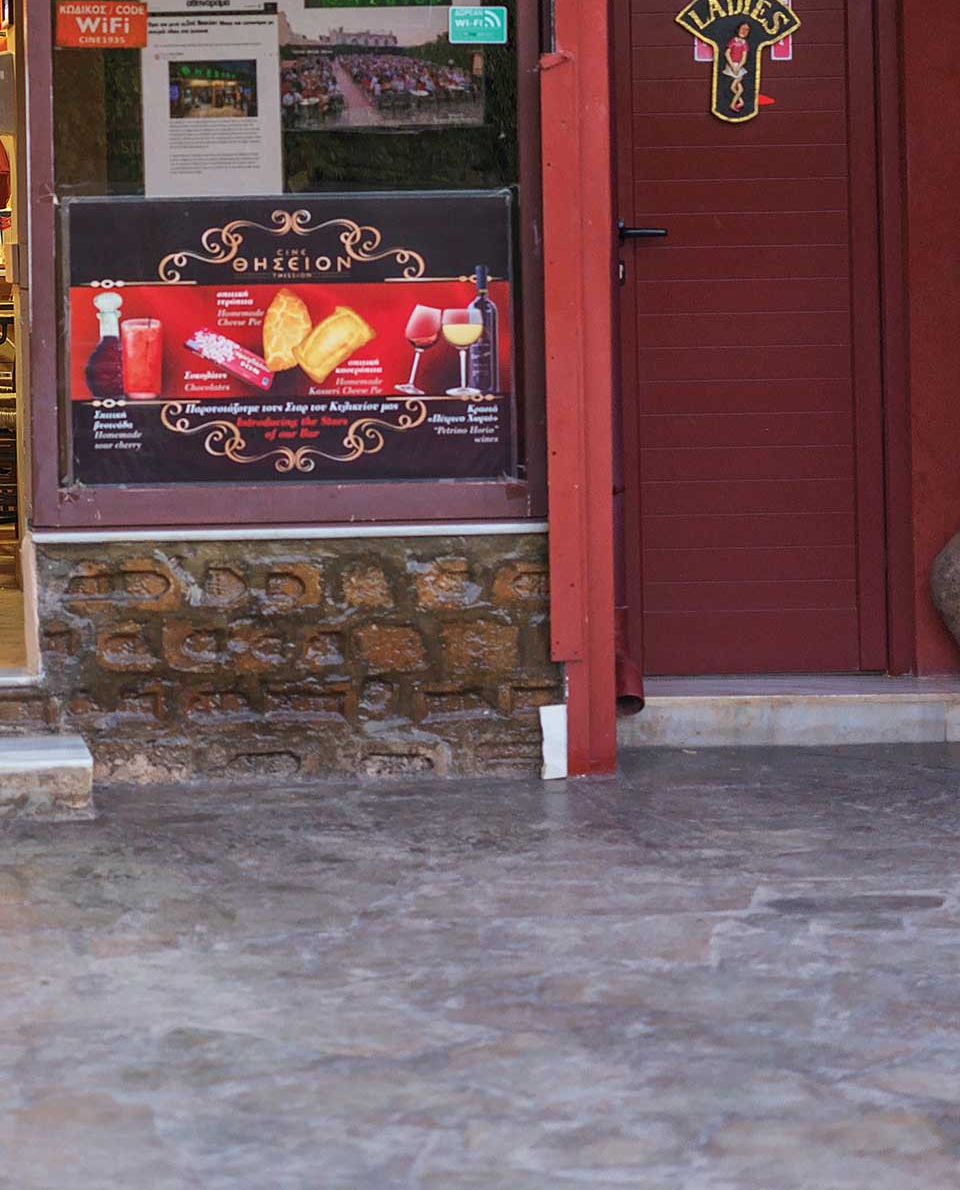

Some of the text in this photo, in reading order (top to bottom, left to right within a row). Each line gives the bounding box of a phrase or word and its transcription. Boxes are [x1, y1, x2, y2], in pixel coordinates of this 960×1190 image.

[60, 5, 107, 15] ΚΩΔΙΚΟΣ
[116, 5, 145, 16] CODE
[76, 16, 130, 35] WiFi
[79, 35, 126, 45] CINE1935
[217, 309, 264, 318] Homemade
[218, 318, 262, 326] Cheese Pie
[184, 383, 230, 391] Chocolates
[336, 378, 382, 386] Homemade
[342, 386, 368, 394] Cheese
[370, 386, 383, 394] Pie
[380, 402, 399, 413] μας
[236, 416, 298, 428] Introducing
[301, 416, 318, 426] the
[94, 430, 142, 440] Homemade
[265, 428, 321, 441] of our Bar
[474, 435, 499, 443] wines
[115, 440, 142, 451] cherry
